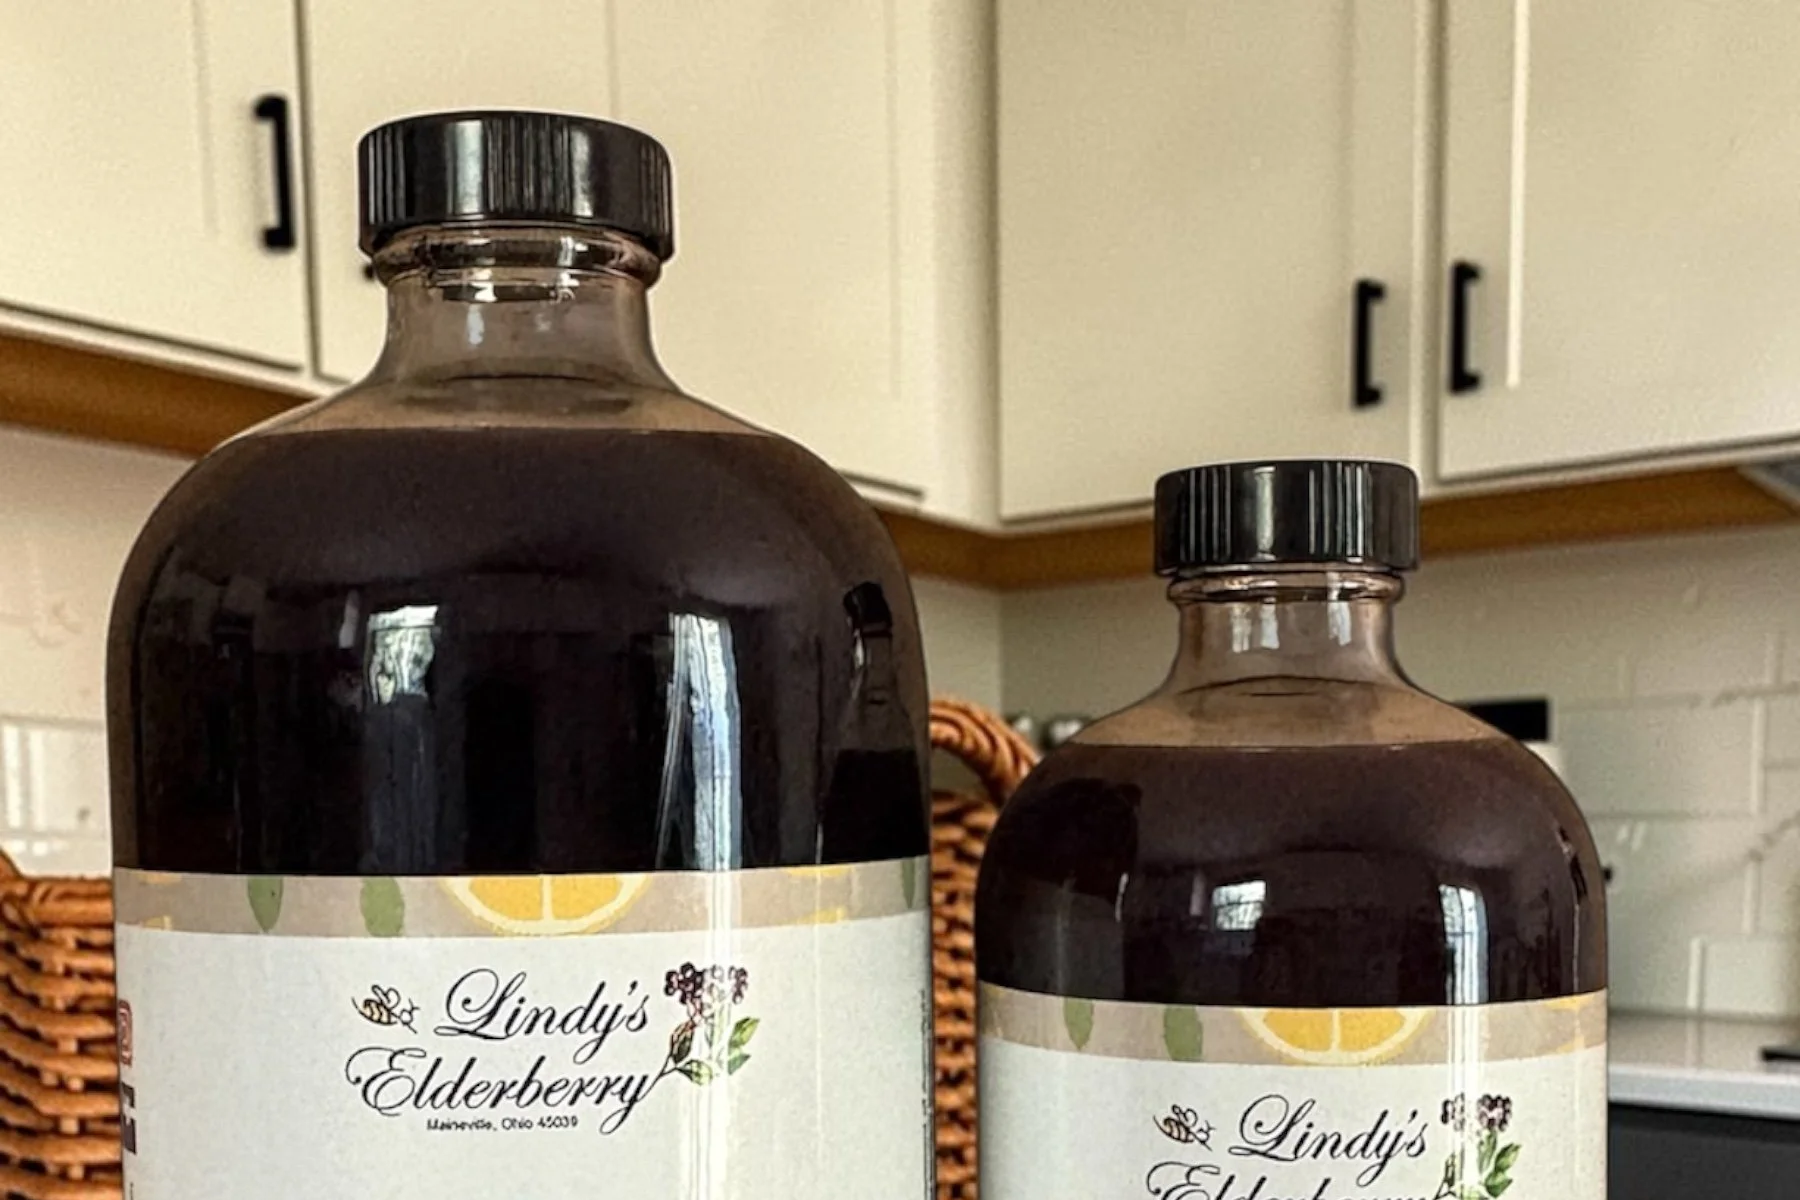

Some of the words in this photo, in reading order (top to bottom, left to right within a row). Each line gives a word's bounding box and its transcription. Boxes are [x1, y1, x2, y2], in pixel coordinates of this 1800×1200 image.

[434, 968, 651, 1065] Lindy's
[345, 1047, 656, 1135] Elderberry
[1228, 1094, 1429, 1187] Lindy's
